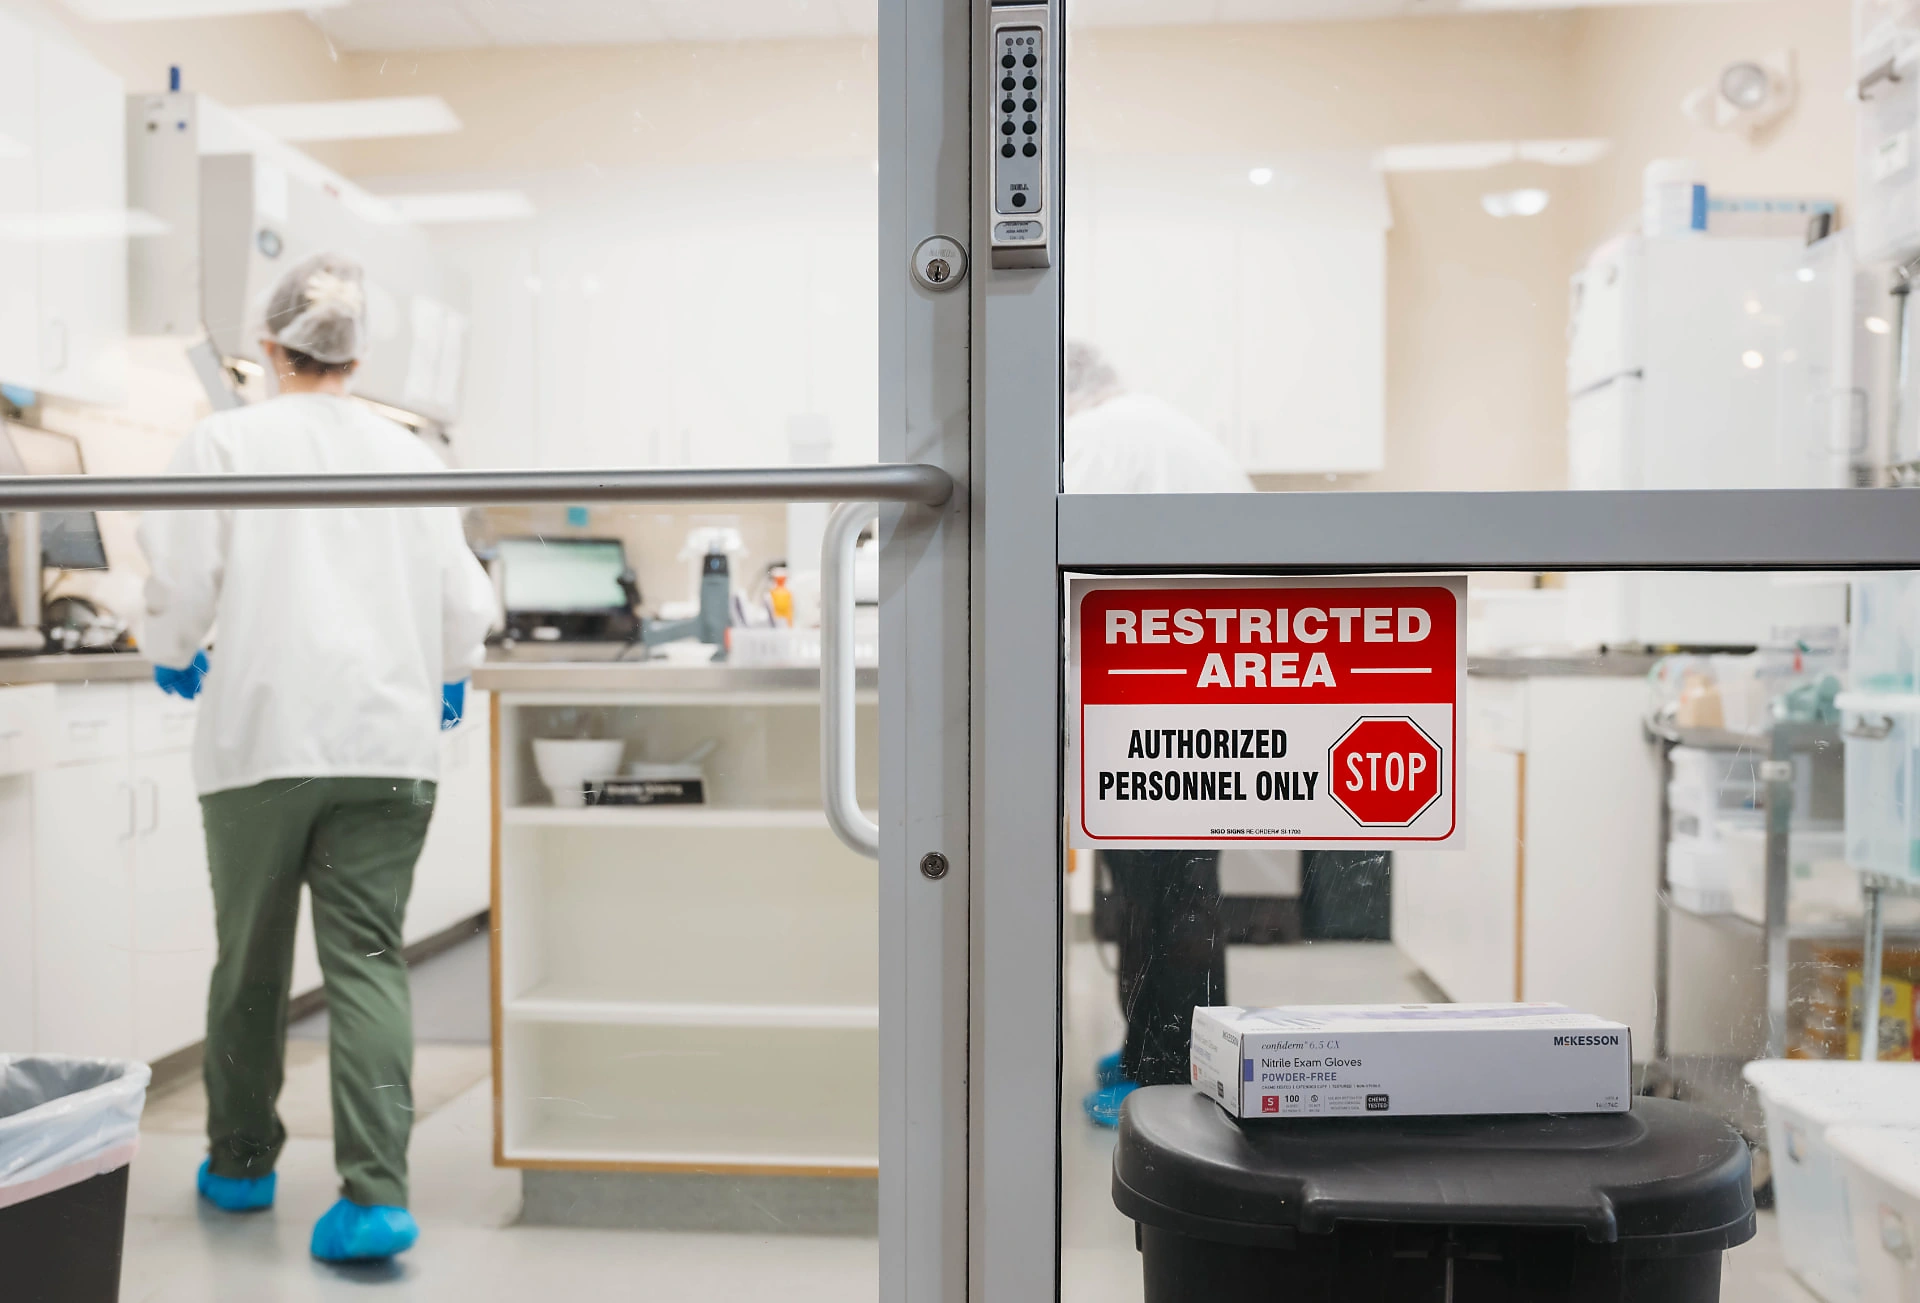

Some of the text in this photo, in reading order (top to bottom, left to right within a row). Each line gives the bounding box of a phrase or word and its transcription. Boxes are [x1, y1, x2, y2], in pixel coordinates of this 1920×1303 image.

[1105, 607, 1432, 645] RESTRICTED
[1196, 652, 1337, 688] AREA
[1127, 729, 1287, 760] AUTHORIZED
[1345, 752, 1427, 792] STOP
[1099, 771, 1319, 801] PERSONNEL ONLY
[1309, 1040, 1324, 1050] 6.5
[1261, 1057, 1362, 1068] Nitrile Exam Gloves
[1261, 1071, 1337, 1082] POWDER-FREE
[1267, 1097, 1274, 1106] S
[1285, 1094, 1300, 1103] 100
